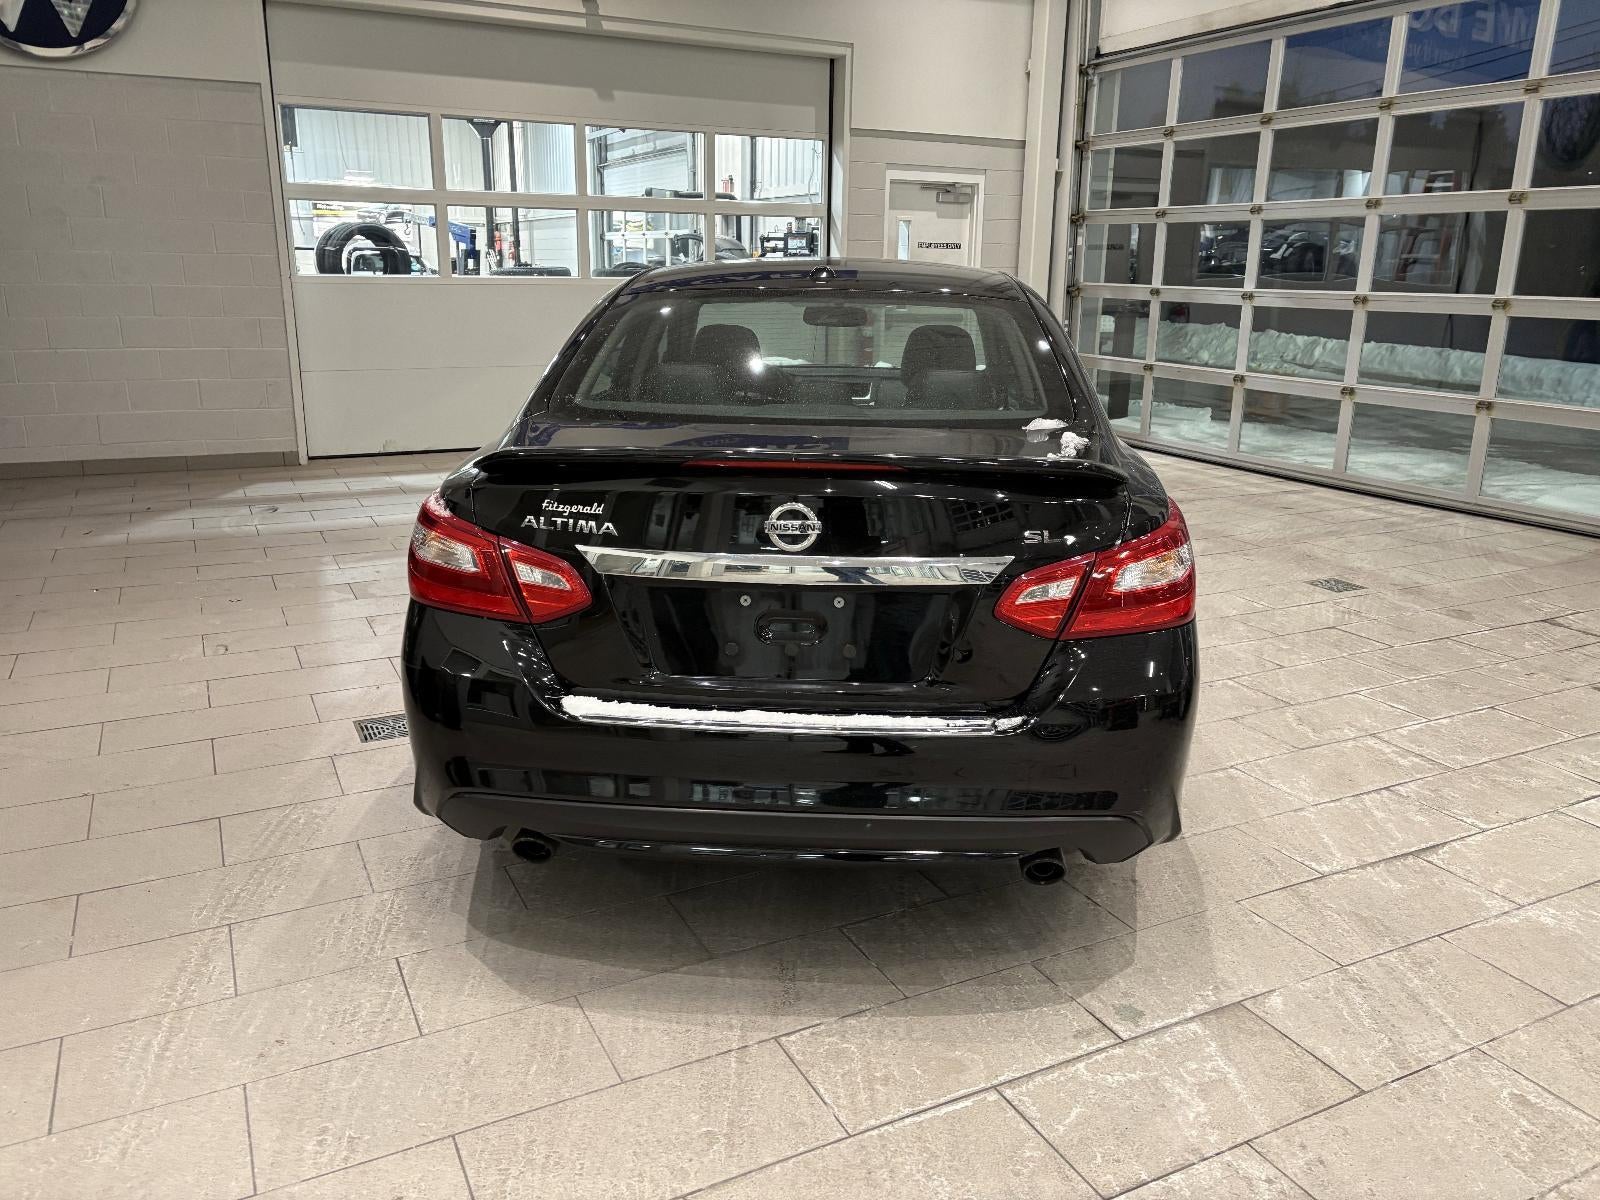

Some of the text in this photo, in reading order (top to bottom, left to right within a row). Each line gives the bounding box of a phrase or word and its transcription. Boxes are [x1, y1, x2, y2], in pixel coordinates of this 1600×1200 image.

[541, 499, 605, 516] Fitzgerald
[520, 515, 619, 537] ALTIMA
[769, 523, 817, 532] NISSAN
[1023, 529, 1063, 544] SL
